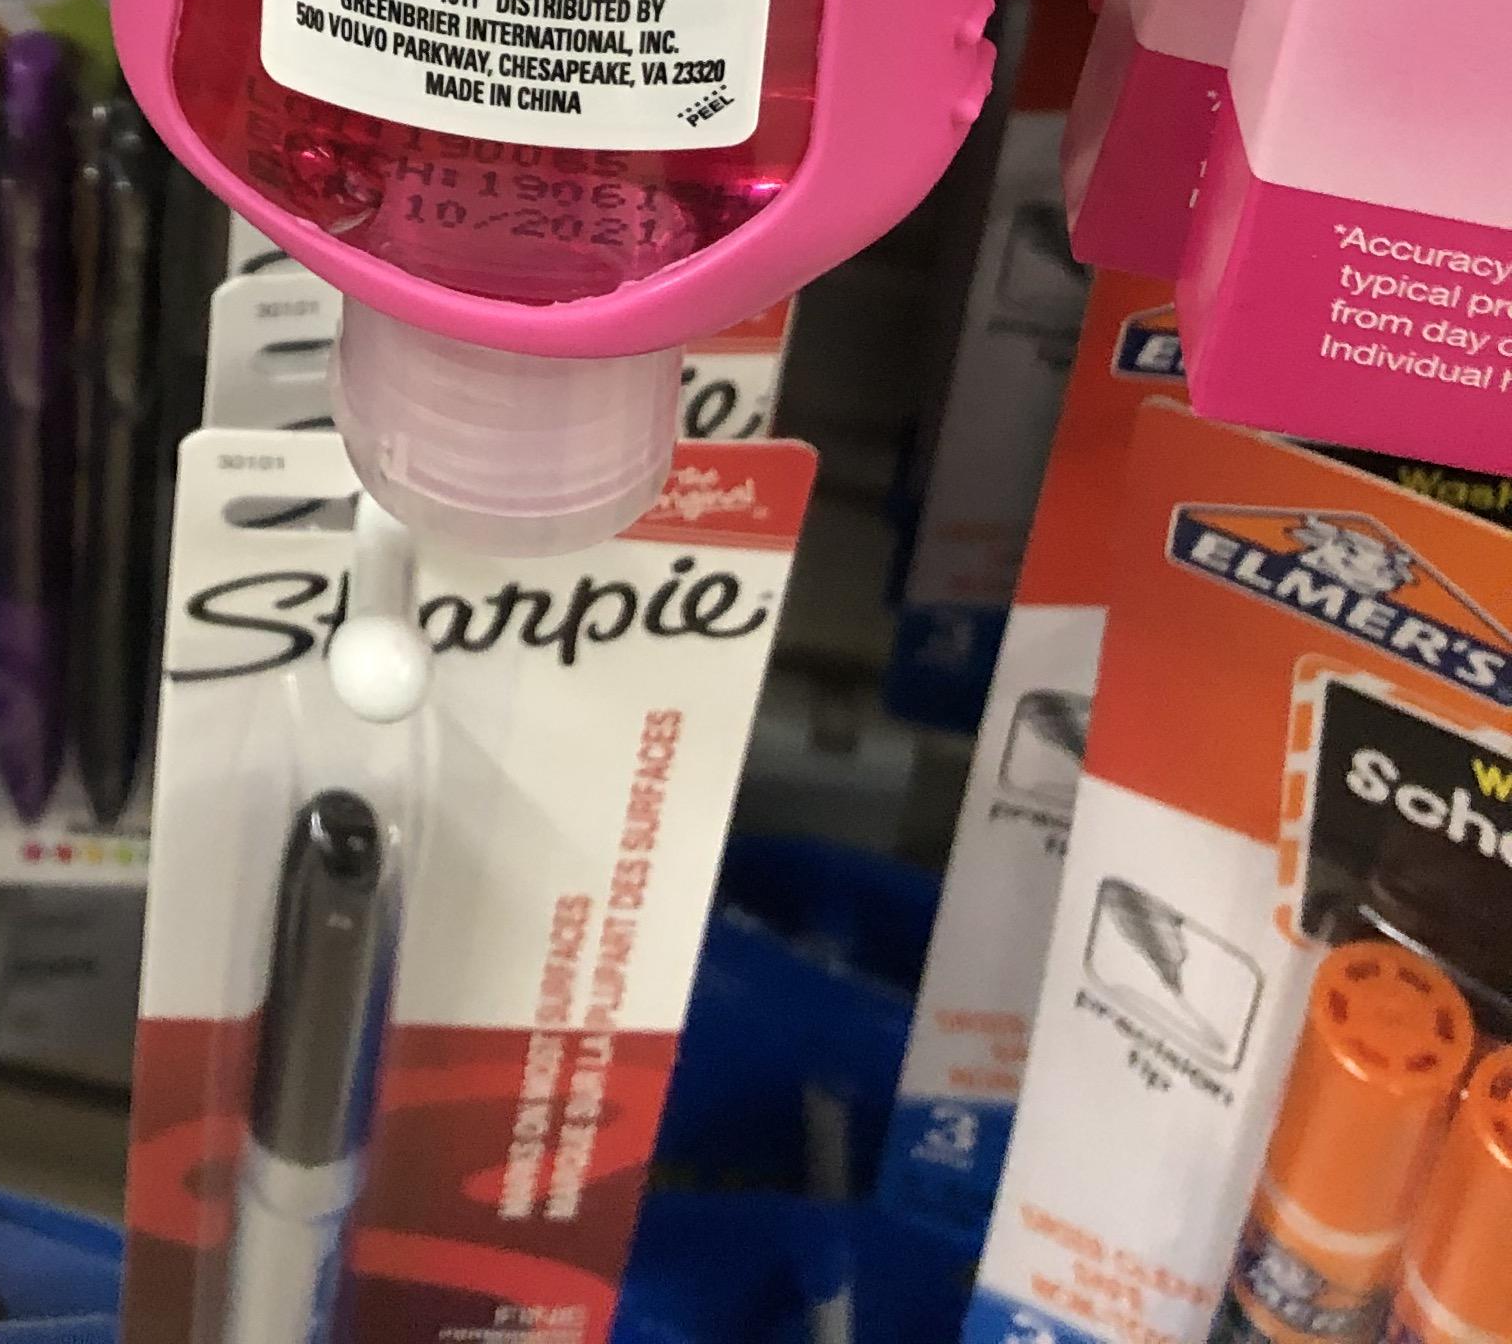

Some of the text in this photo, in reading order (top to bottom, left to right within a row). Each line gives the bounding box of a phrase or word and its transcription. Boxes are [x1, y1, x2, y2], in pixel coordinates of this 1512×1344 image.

[295, 0, 726, 88] 500 VOLVO PARKWAY, CHESAPEAKE, VA 23320
[466, 16, 634, 57] INTERNATIONAL,
[639, 29, 680, 55] INC.
[425, 71, 583, 116] MADE IN CHINA
[686, 93, 737, 129] PEEL
[1340, 263, 1463, 309] typical
[1330, 298, 1415, 338] from
[1421, 319, 1492, 356] day
[1319, 332, 1494, 391] Individual
[1190, 528, 1510, 689] ELMER'S
[619, 707, 684, 854] SURFACES
